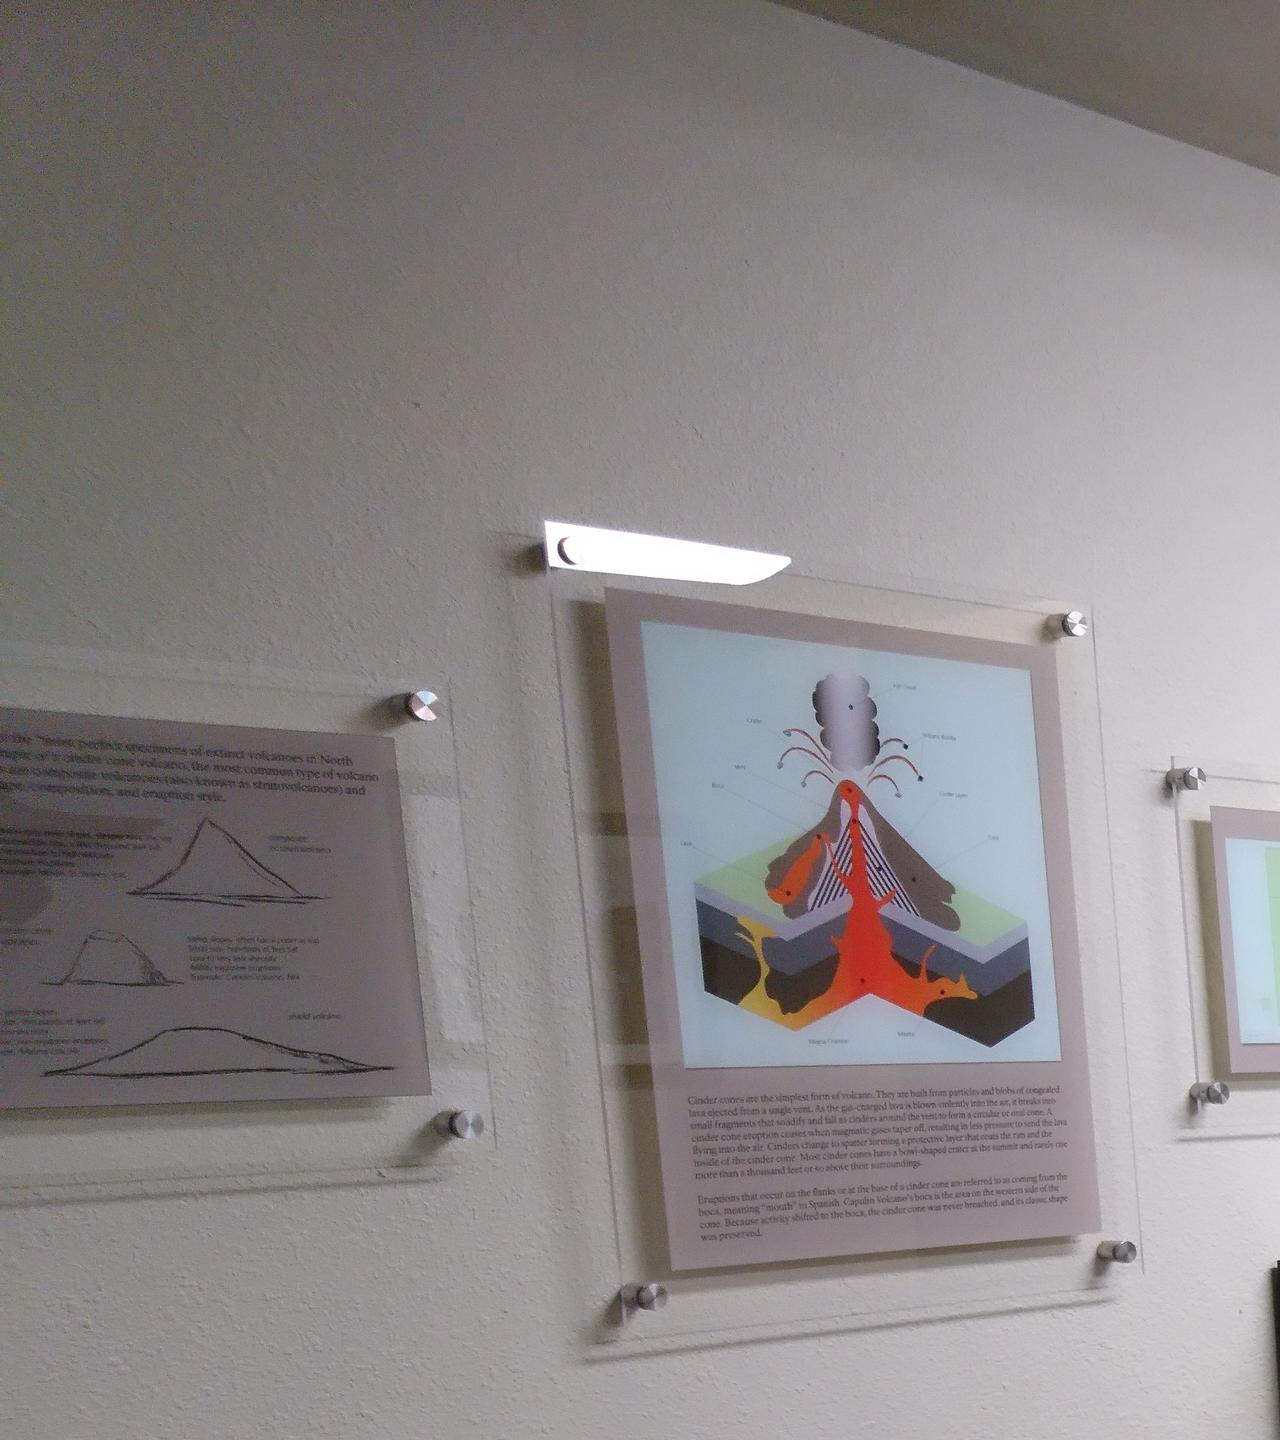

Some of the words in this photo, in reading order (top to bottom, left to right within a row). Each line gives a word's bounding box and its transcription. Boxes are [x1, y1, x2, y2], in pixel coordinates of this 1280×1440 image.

[205, 746, 245, 758] extinct
[319, 754, 352, 765] North
[213, 762, 242, 773] most
[244, 767, 293, 776] common
[295, 767, 320, 780] type
[335, 770, 378, 781] volcano
[115, 787, 140, 797] and
[344, 785, 365, 794] and
